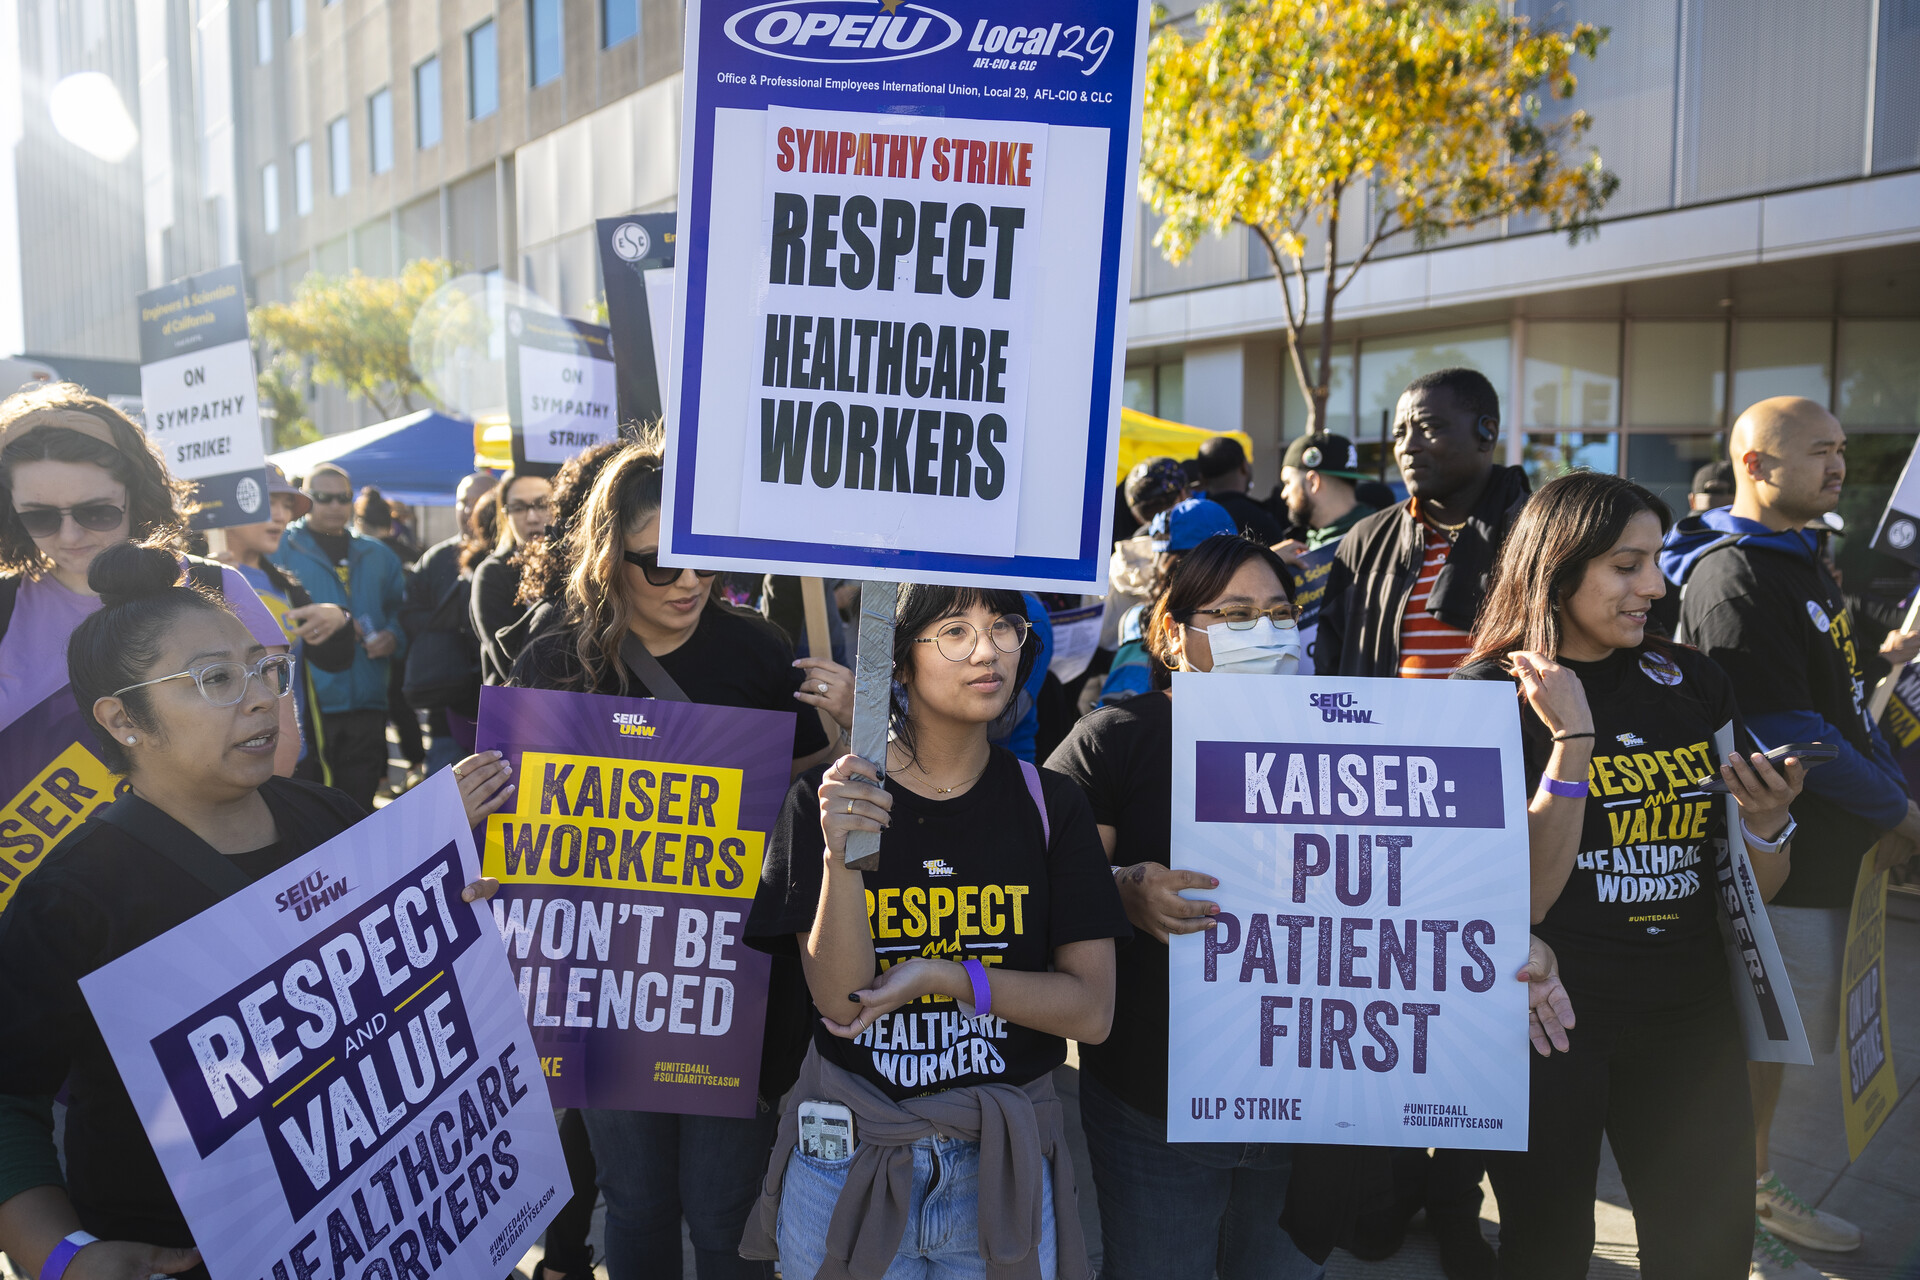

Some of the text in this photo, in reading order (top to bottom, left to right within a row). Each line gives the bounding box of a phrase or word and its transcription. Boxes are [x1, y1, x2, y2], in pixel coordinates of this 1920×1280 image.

[754, 10, 933, 51] OPEIU
[967, 19, 1115, 77] Local 29
[973, 57, 1037, 71] AFL-CIO & CLC
[717, 72, 1113, 103] Office & Professional Employees International Union, Local 29, AFL-CIO & CLC
[776, 126, 1034, 187] SYMPATHY STRIKE
[769, 192, 1026, 300] RESPECT
[184, 366, 205, 388] ON
[562, 368, 583, 384] ON
[762, 313, 1010, 404] HEALTHCARE
[156, 395, 244, 431] SYMPATHY
[531, 395, 609, 419] SYMPATHY
[177, 437, 230, 463] STRIKE!
[760, 398, 1008, 501] WORKERS
[612, 712, 647, 725] SEIU-
[1309, 693, 1358, 708] SEIU-
[1322, 709, 1373, 724] UHW
[620, 724, 656, 737] UHW
[540, 762, 720, 828] KAISER
[1245, 752, 1457, 818] KAISER:
[1644, 782, 1678, 808] and
[1608, 801, 1712, 847] VALUE
[502, 822, 746, 890] WORKERS
[922, 859, 947, 868] SEIU-
[928, 867, 954, 875] UHW
[1291, 833, 1413, 907] PUT
[275, 869, 329, 913] SEIU-
[294, 876, 348, 922] UHW
[1596, 869, 1700, 903] WORKERS
[493, 898, 742, 971] WON'T BE
[1628, 913, 1680, 922] #UNITED4ALL
[921, 929, 962, 957] and
[1204, 912, 1496, 993] PATIENTS
[187, 860, 460, 1120] RESPECT
[518, 966, 734, 1036] ILENCED
[344, 1012, 388, 1059] AND
[1259, 996, 1441, 1074] FIRST
[653, 1072, 740, 1087] #SOLIDARITYSEASON
[654, 1061, 711, 1075] #UNITED4ALL
[872, 1037, 1006, 1087] WORKERS
[278, 991, 468, 1192] VALUE
[1191, 1097, 1302, 1121] ULP STRIKE
[1403, 1103, 1468, 1116] #UNITED4ALL
[1403, 1116, 1503, 1130] #SOLIDARITYSEASON
[258, 1042, 528, 1280] EALTHCARE
[360, 1130, 520, 1280] RKERS
[491, 1186, 556, 1267] #SOLIDARITYSEASON
[488, 1201, 532, 1256] #UNITED4ALL
